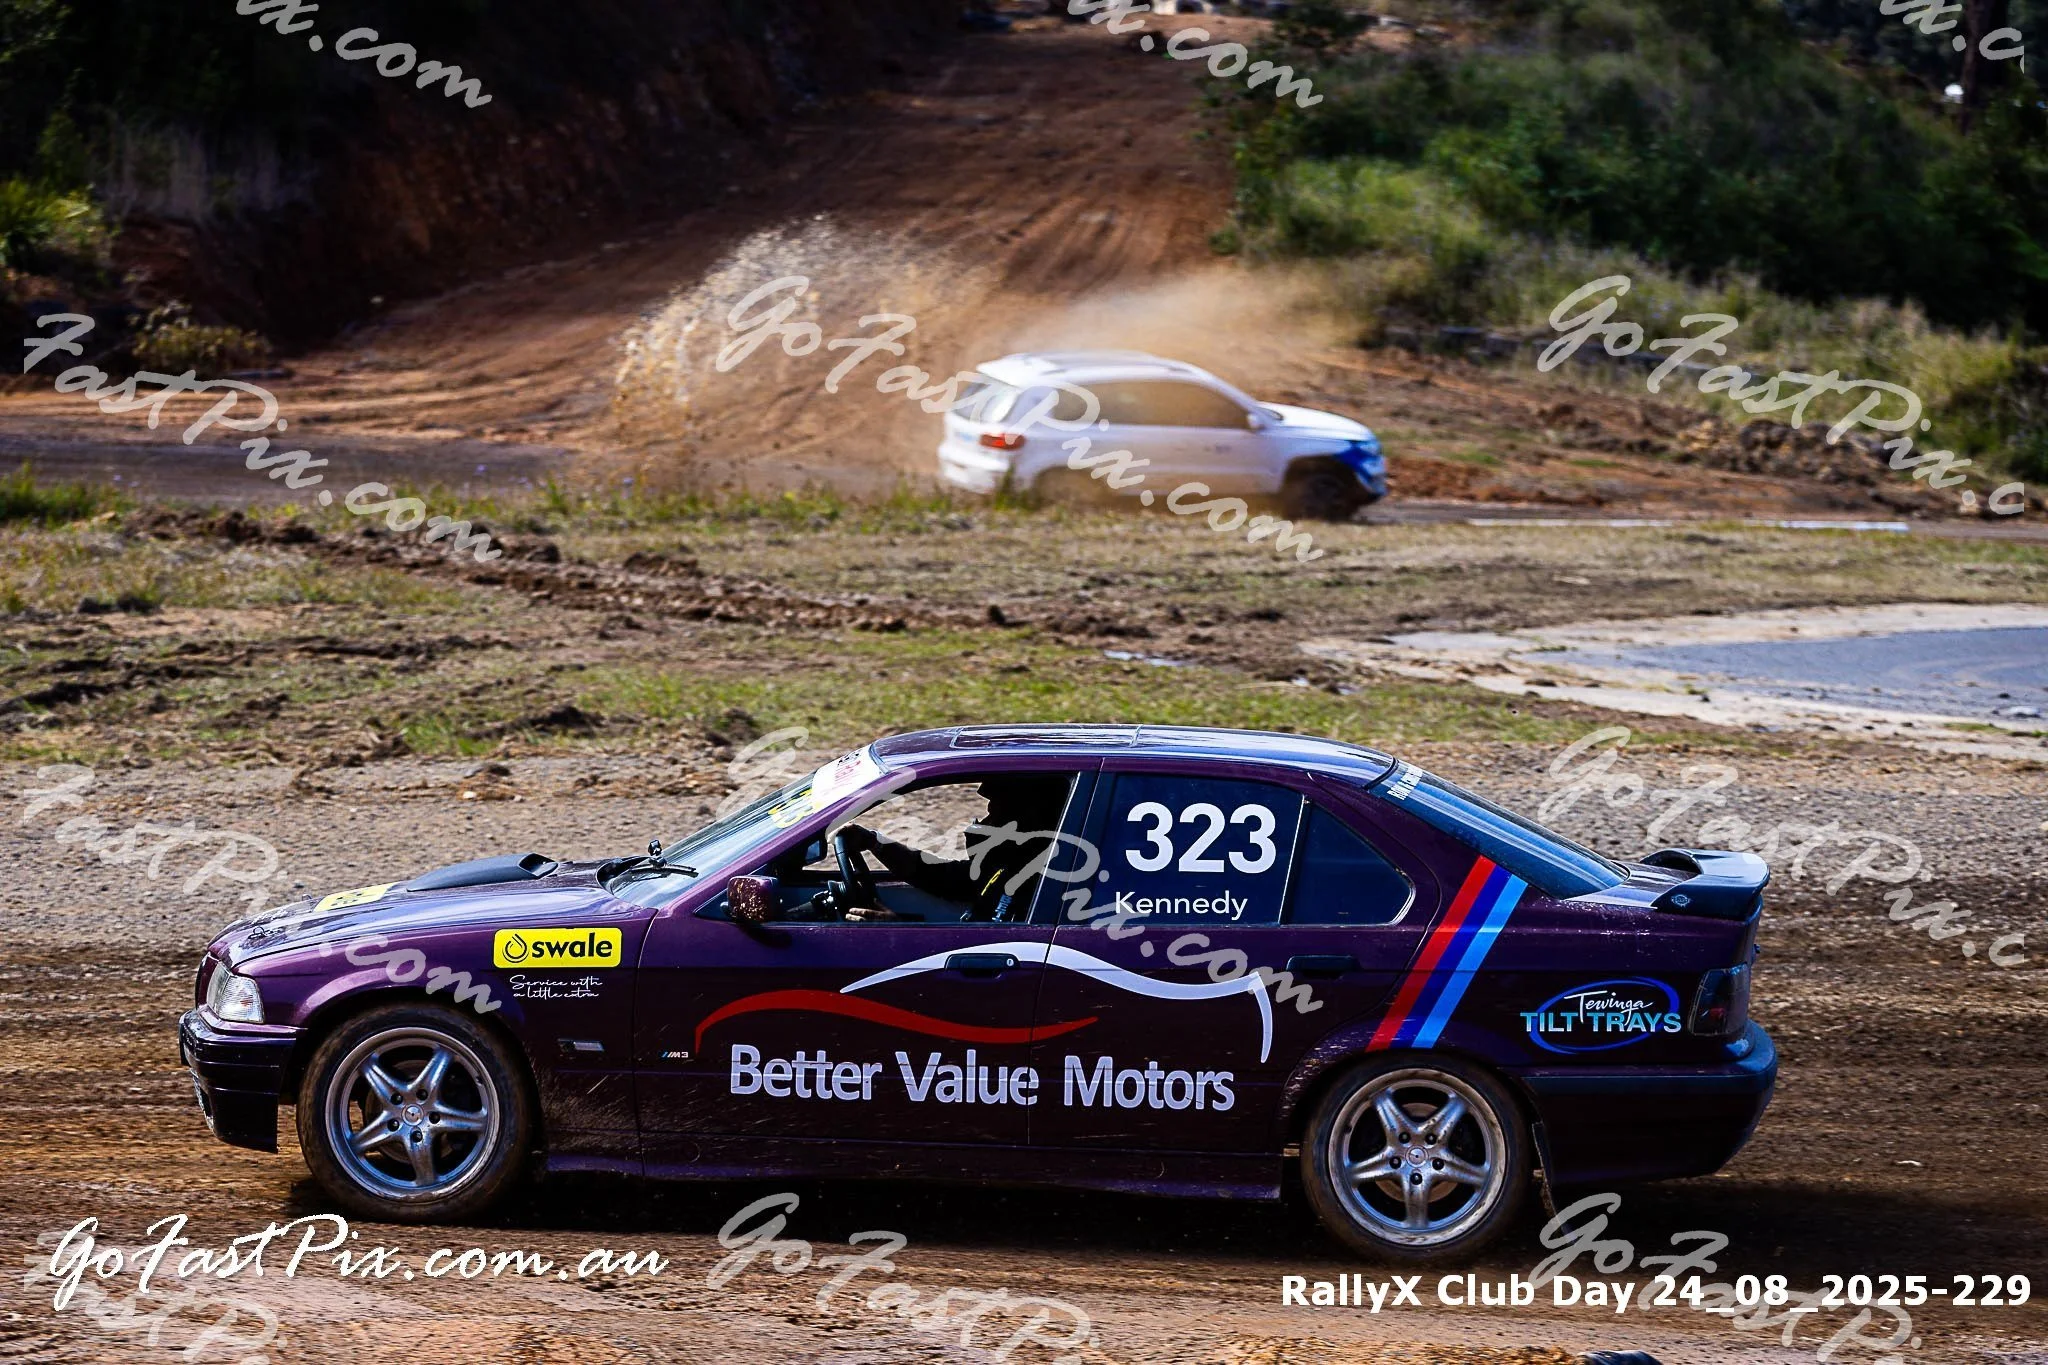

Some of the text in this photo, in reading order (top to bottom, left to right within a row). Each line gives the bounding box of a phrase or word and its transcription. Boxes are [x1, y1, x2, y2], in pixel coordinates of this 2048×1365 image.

[1125, 801, 1277, 874] 323
[1115, 889, 1248, 921] Kennedy
[531, 932, 613, 958] swale
[509, 974, 603, 990] Service with
[527, 986, 563, 1000] little
[1520, 1012, 1682, 1033] TILT TRAYS
[1563, 990, 1655, 1027] Tewinga
[730, 1044, 1235, 1111] Better Value Motors
